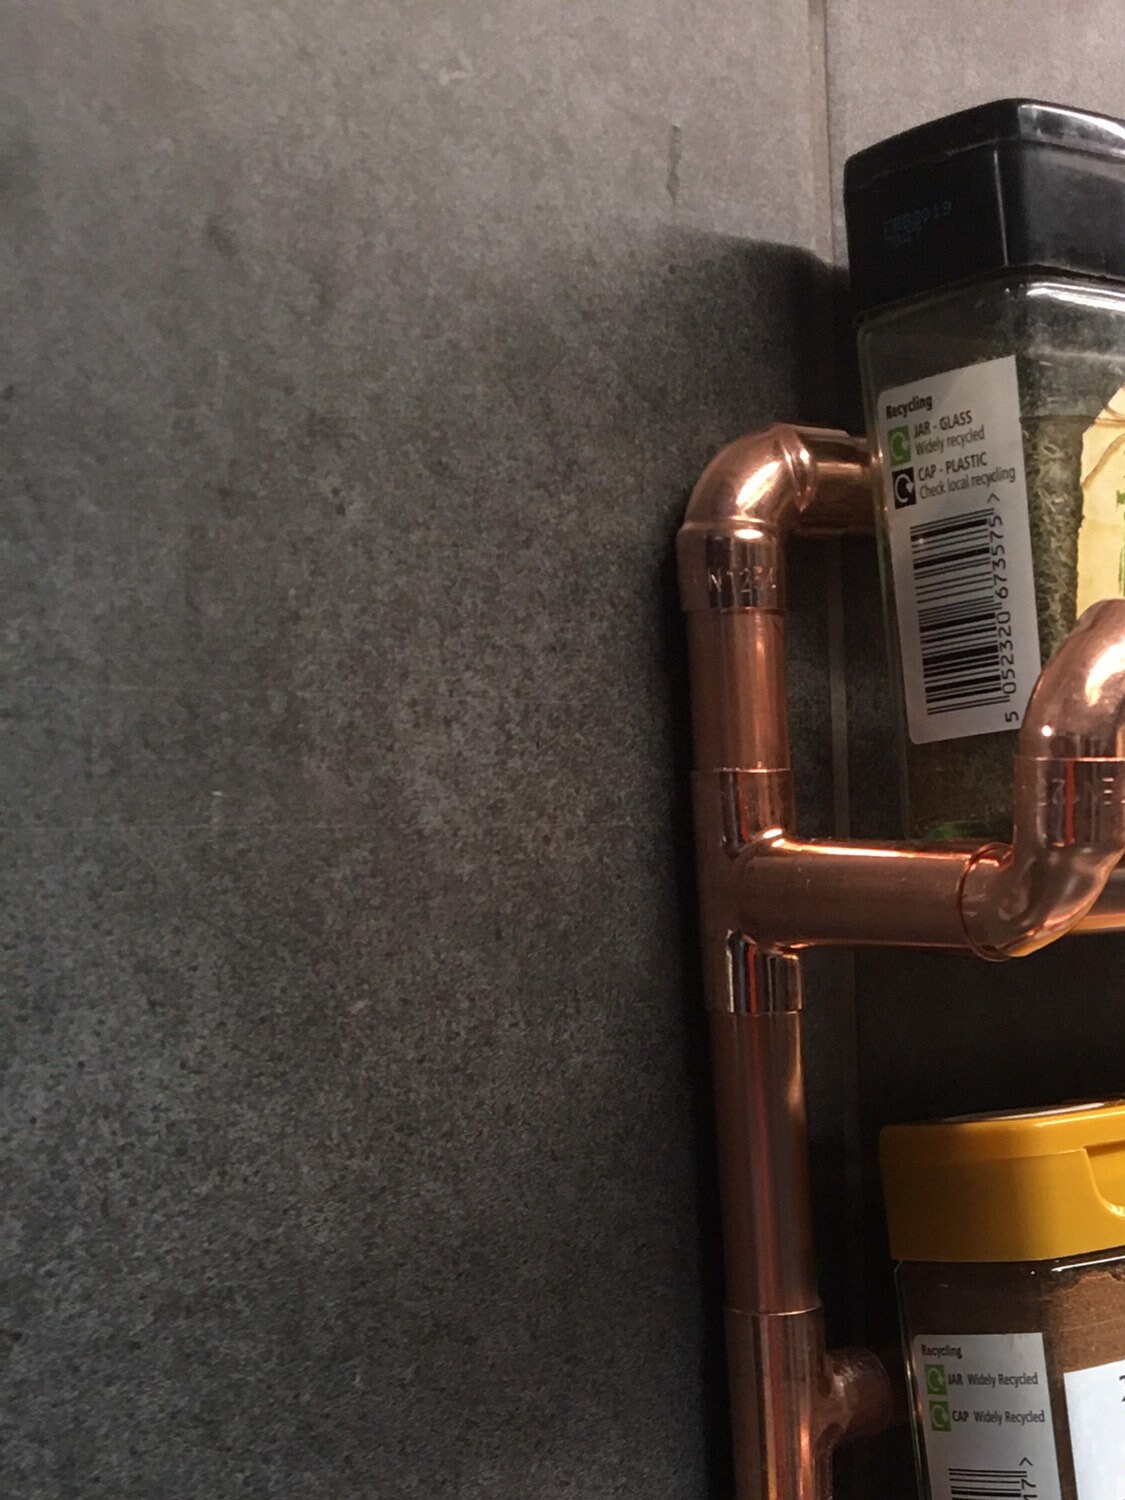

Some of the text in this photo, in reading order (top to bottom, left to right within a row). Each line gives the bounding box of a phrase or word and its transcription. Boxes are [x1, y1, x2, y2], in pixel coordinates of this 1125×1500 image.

[886, 395, 933, 420] Recycling
[914, 420, 930, 438] JAR
[939, 410, 973, 431] GLASS
[914, 424, 985, 456] Widely recycled
[917, 464, 937, 481] CAP
[946, 452, 988, 474] PLASTIC
[919, 466, 1016, 500] Check local recycling
[988, 514, 1009, 599] 673575
[996, 610, 1017, 695] 052320
[921, 1343, 962, 1359] Recycling
[968, 1373, 996, 1388] Widely
[998, 1372, 1038, 1388] Recycled
[952, 1410, 1045, 1426] CAP Widely Recycled
